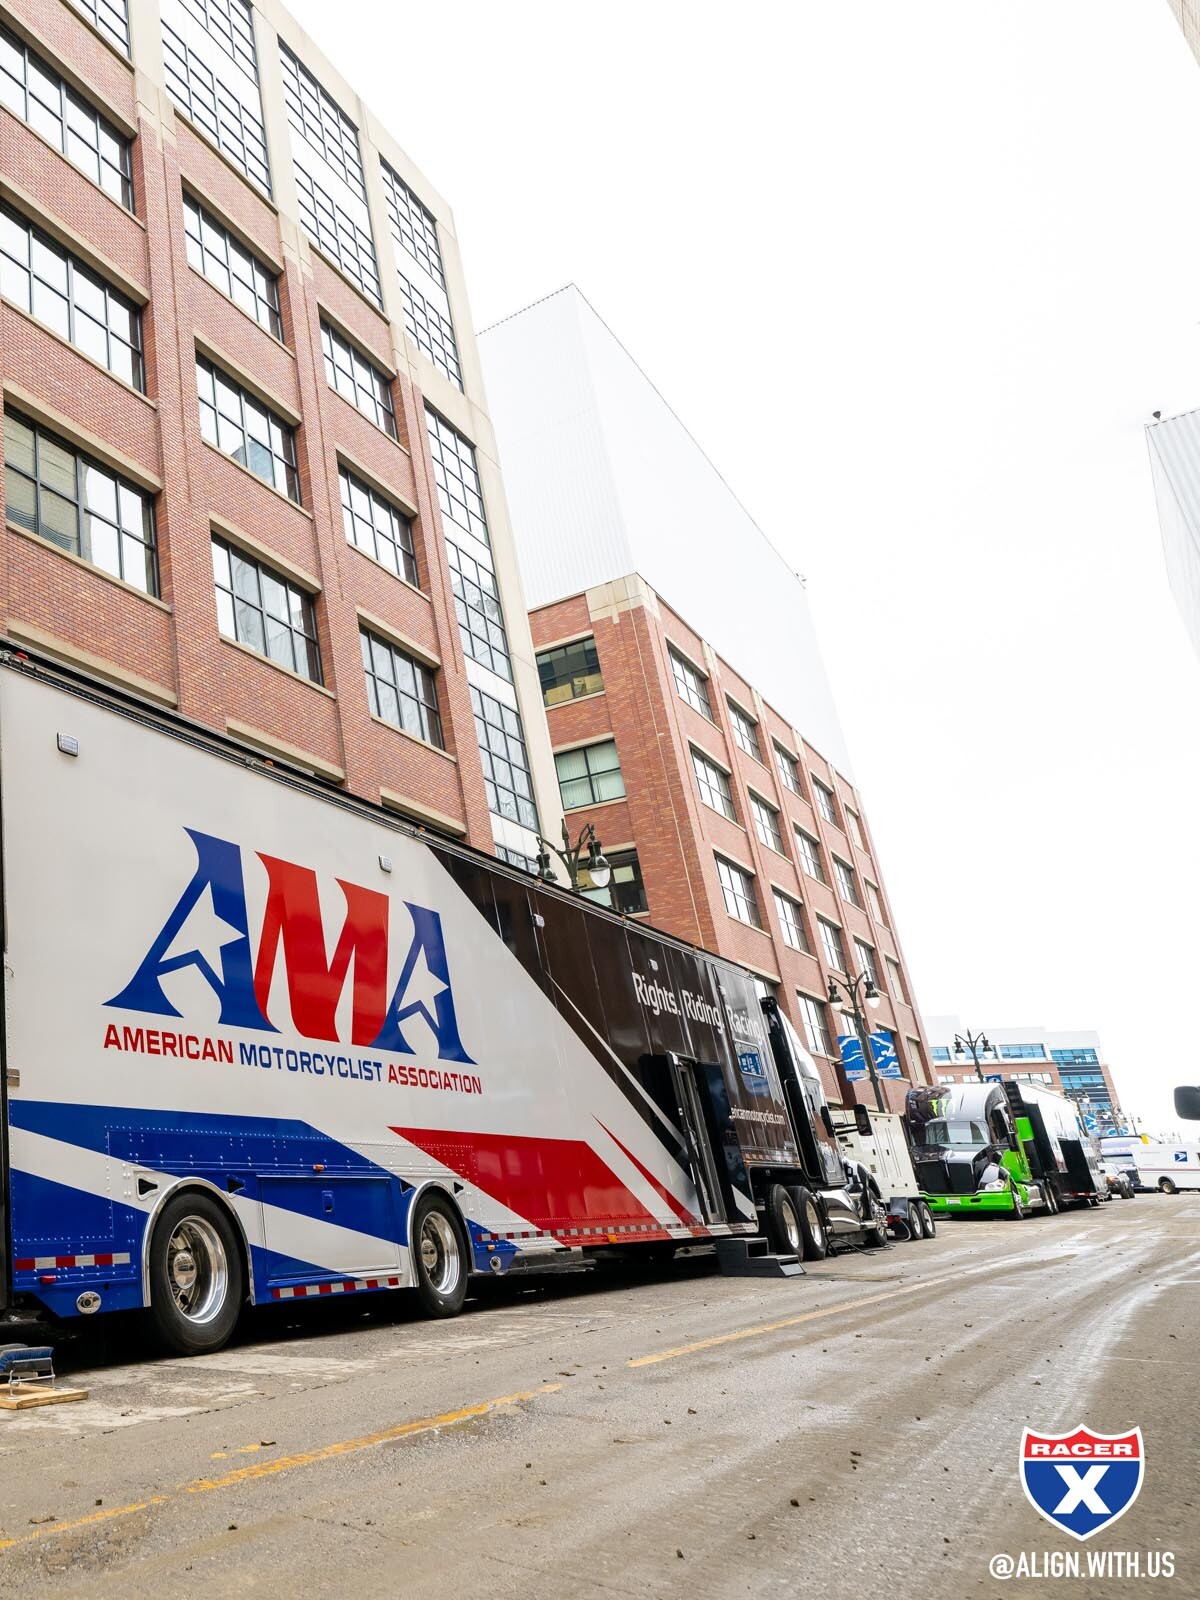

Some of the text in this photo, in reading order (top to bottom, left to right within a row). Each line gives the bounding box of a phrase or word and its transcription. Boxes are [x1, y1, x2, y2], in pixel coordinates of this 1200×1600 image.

[101, 826, 479, 1066] AMA
[632, 972, 681, 1016] Rights.
[104, 1024, 482, 1095] AMERICAN MOTORCYCLIST ASSOCIATION
